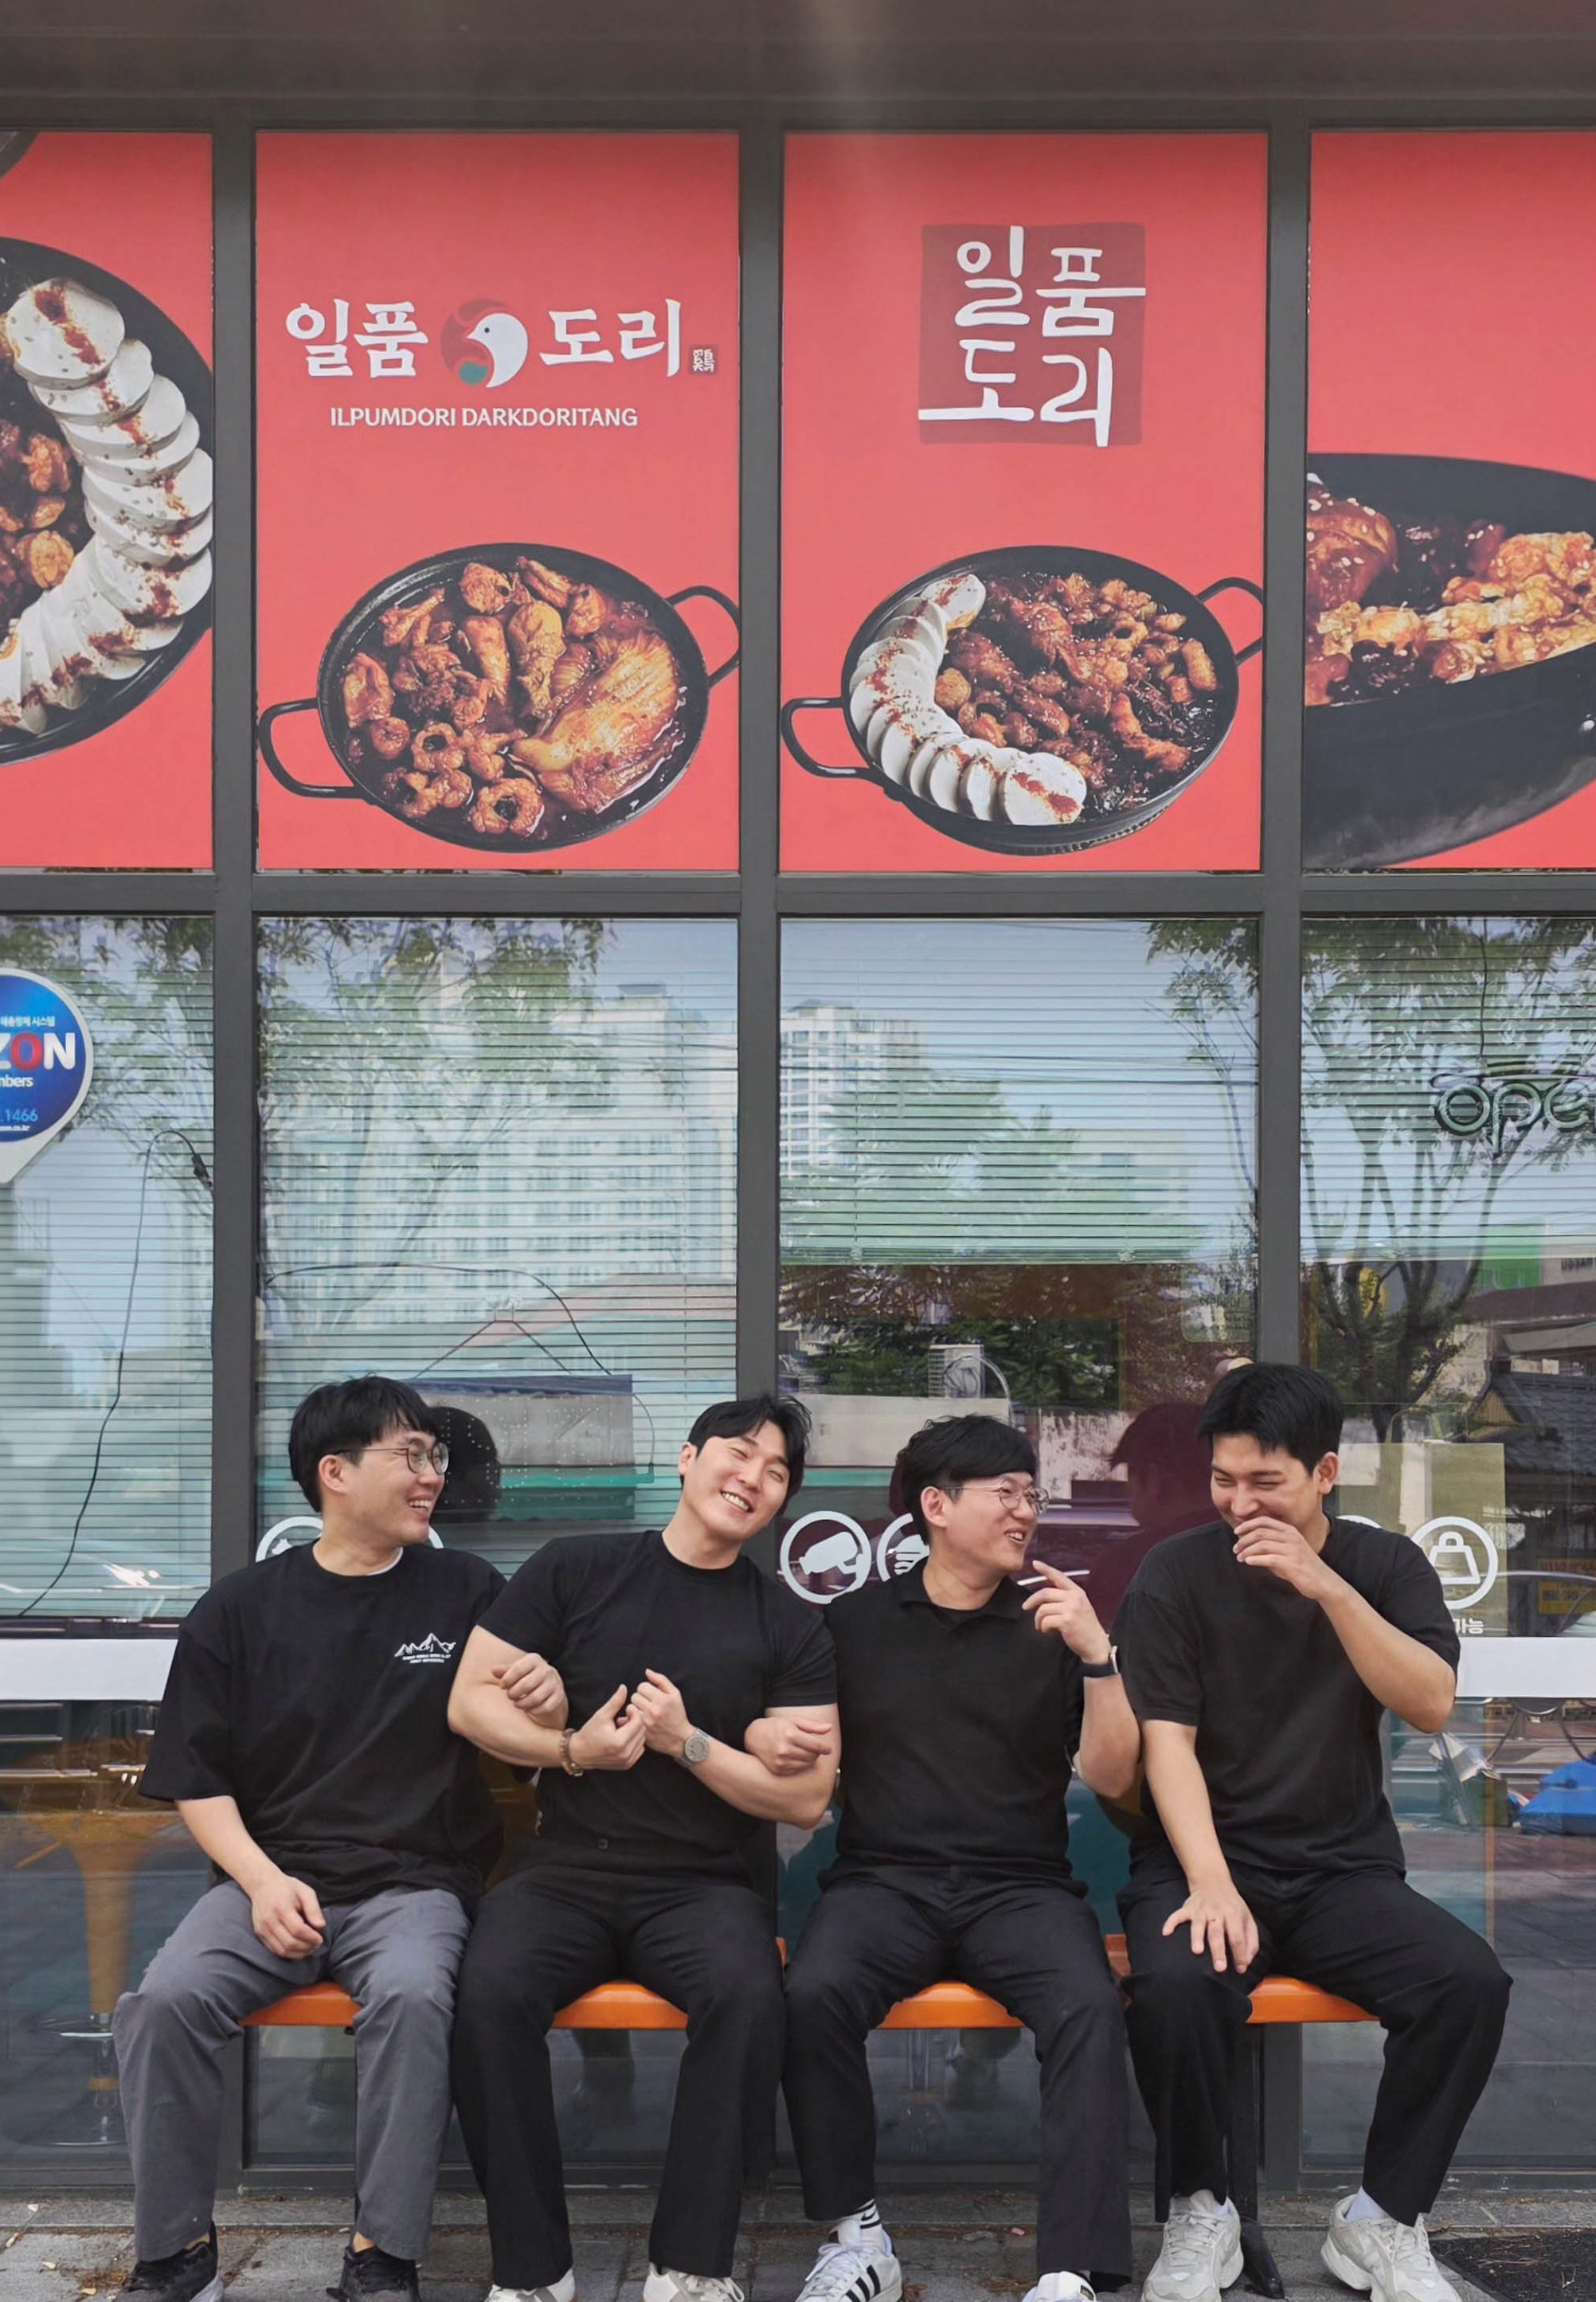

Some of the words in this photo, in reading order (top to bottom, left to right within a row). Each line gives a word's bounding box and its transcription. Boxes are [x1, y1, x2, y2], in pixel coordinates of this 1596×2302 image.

[955, 226, 1146, 336] 일품
[286, 299, 428, 378] 일품
[540, 299, 681, 377] 도리
[331, 407, 456, 427] ILPUMDORI
[462, 407, 638, 427] DARKDORITANG
[918, 339, 1113, 447] 도리
[32, 1016, 56, 1028] 시스템
[1434, 1081, 1596, 1160] ope
